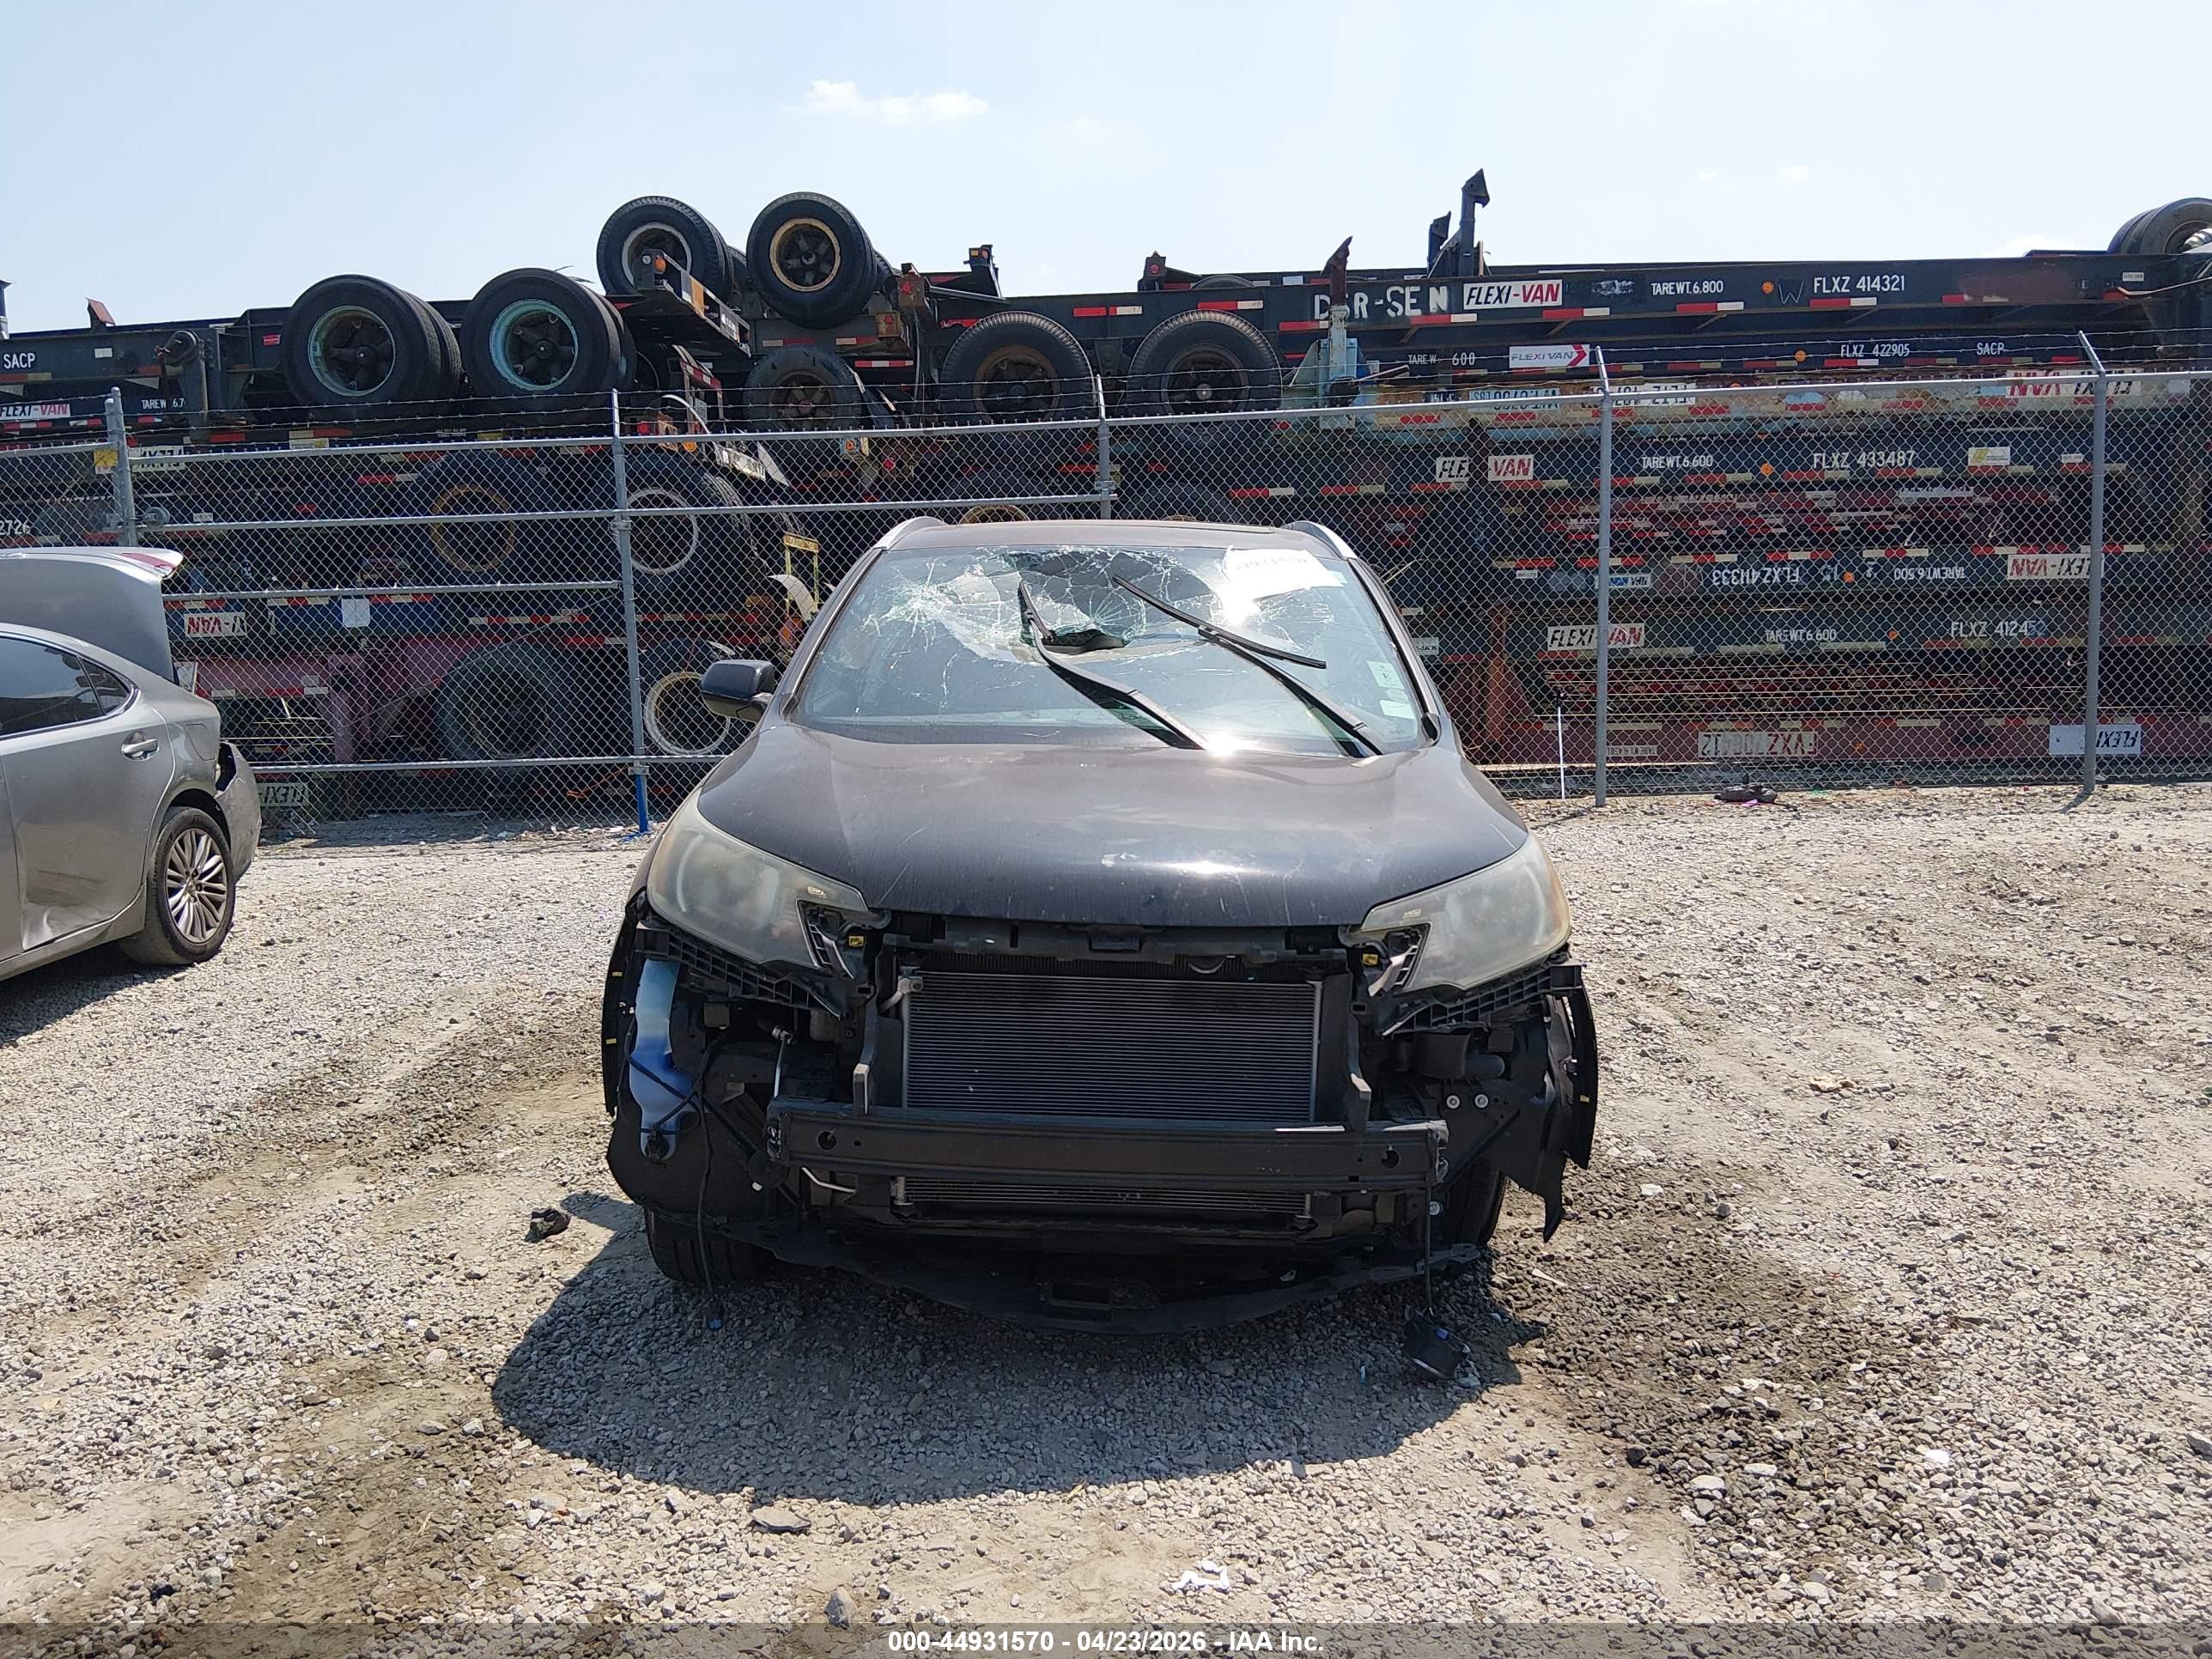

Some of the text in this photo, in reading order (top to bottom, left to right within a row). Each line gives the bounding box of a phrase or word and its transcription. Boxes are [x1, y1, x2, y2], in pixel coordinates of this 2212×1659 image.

[1814, 274, 1905, 294] FLXZ 414321
[1466, 283, 1559, 306] FLEXI-VAN
[1840, 343, 1910, 357] FLXZ 422905
[1977, 343, 2005, 356] SACP
[3, 352, 35, 369] SACP
[1813, 450, 1916, 468] FLXZ 433487
[1949, 622, 1986, 638] FLXZ
